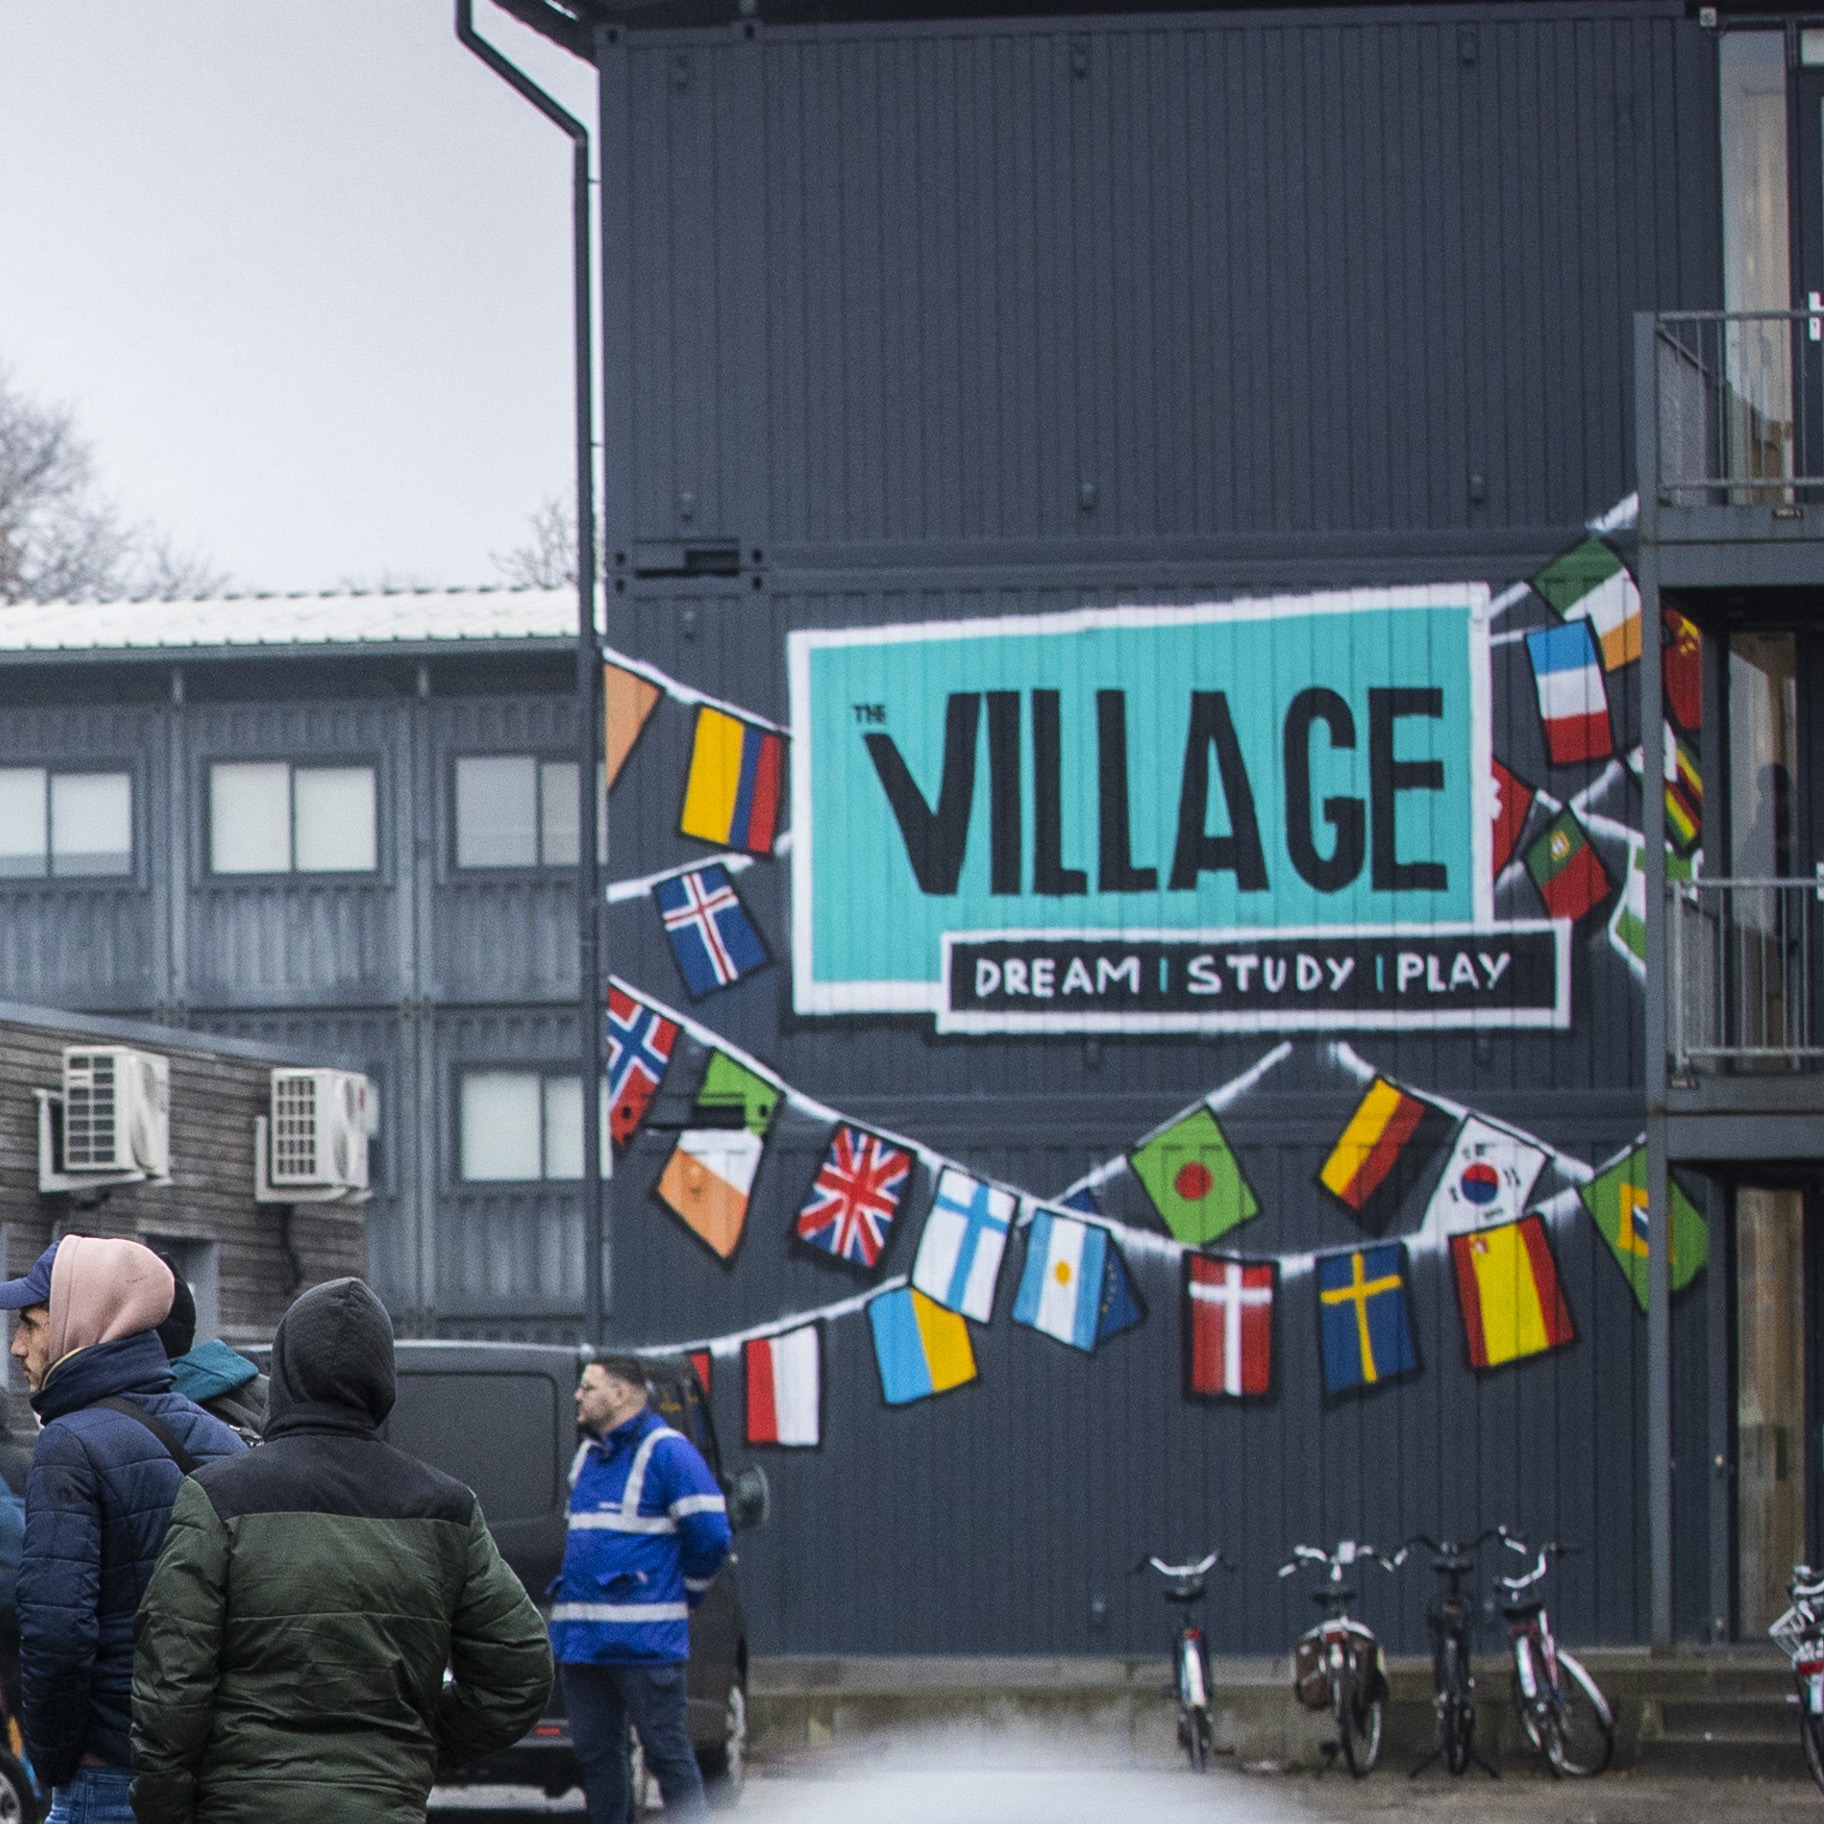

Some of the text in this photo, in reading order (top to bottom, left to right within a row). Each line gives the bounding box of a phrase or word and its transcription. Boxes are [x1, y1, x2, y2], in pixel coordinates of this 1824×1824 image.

[853, 703, 886, 725] THE
[862, 687, 1449, 897] VILLAGE
[974, 952, 1512, 998] DREAM STUDY PLAY
